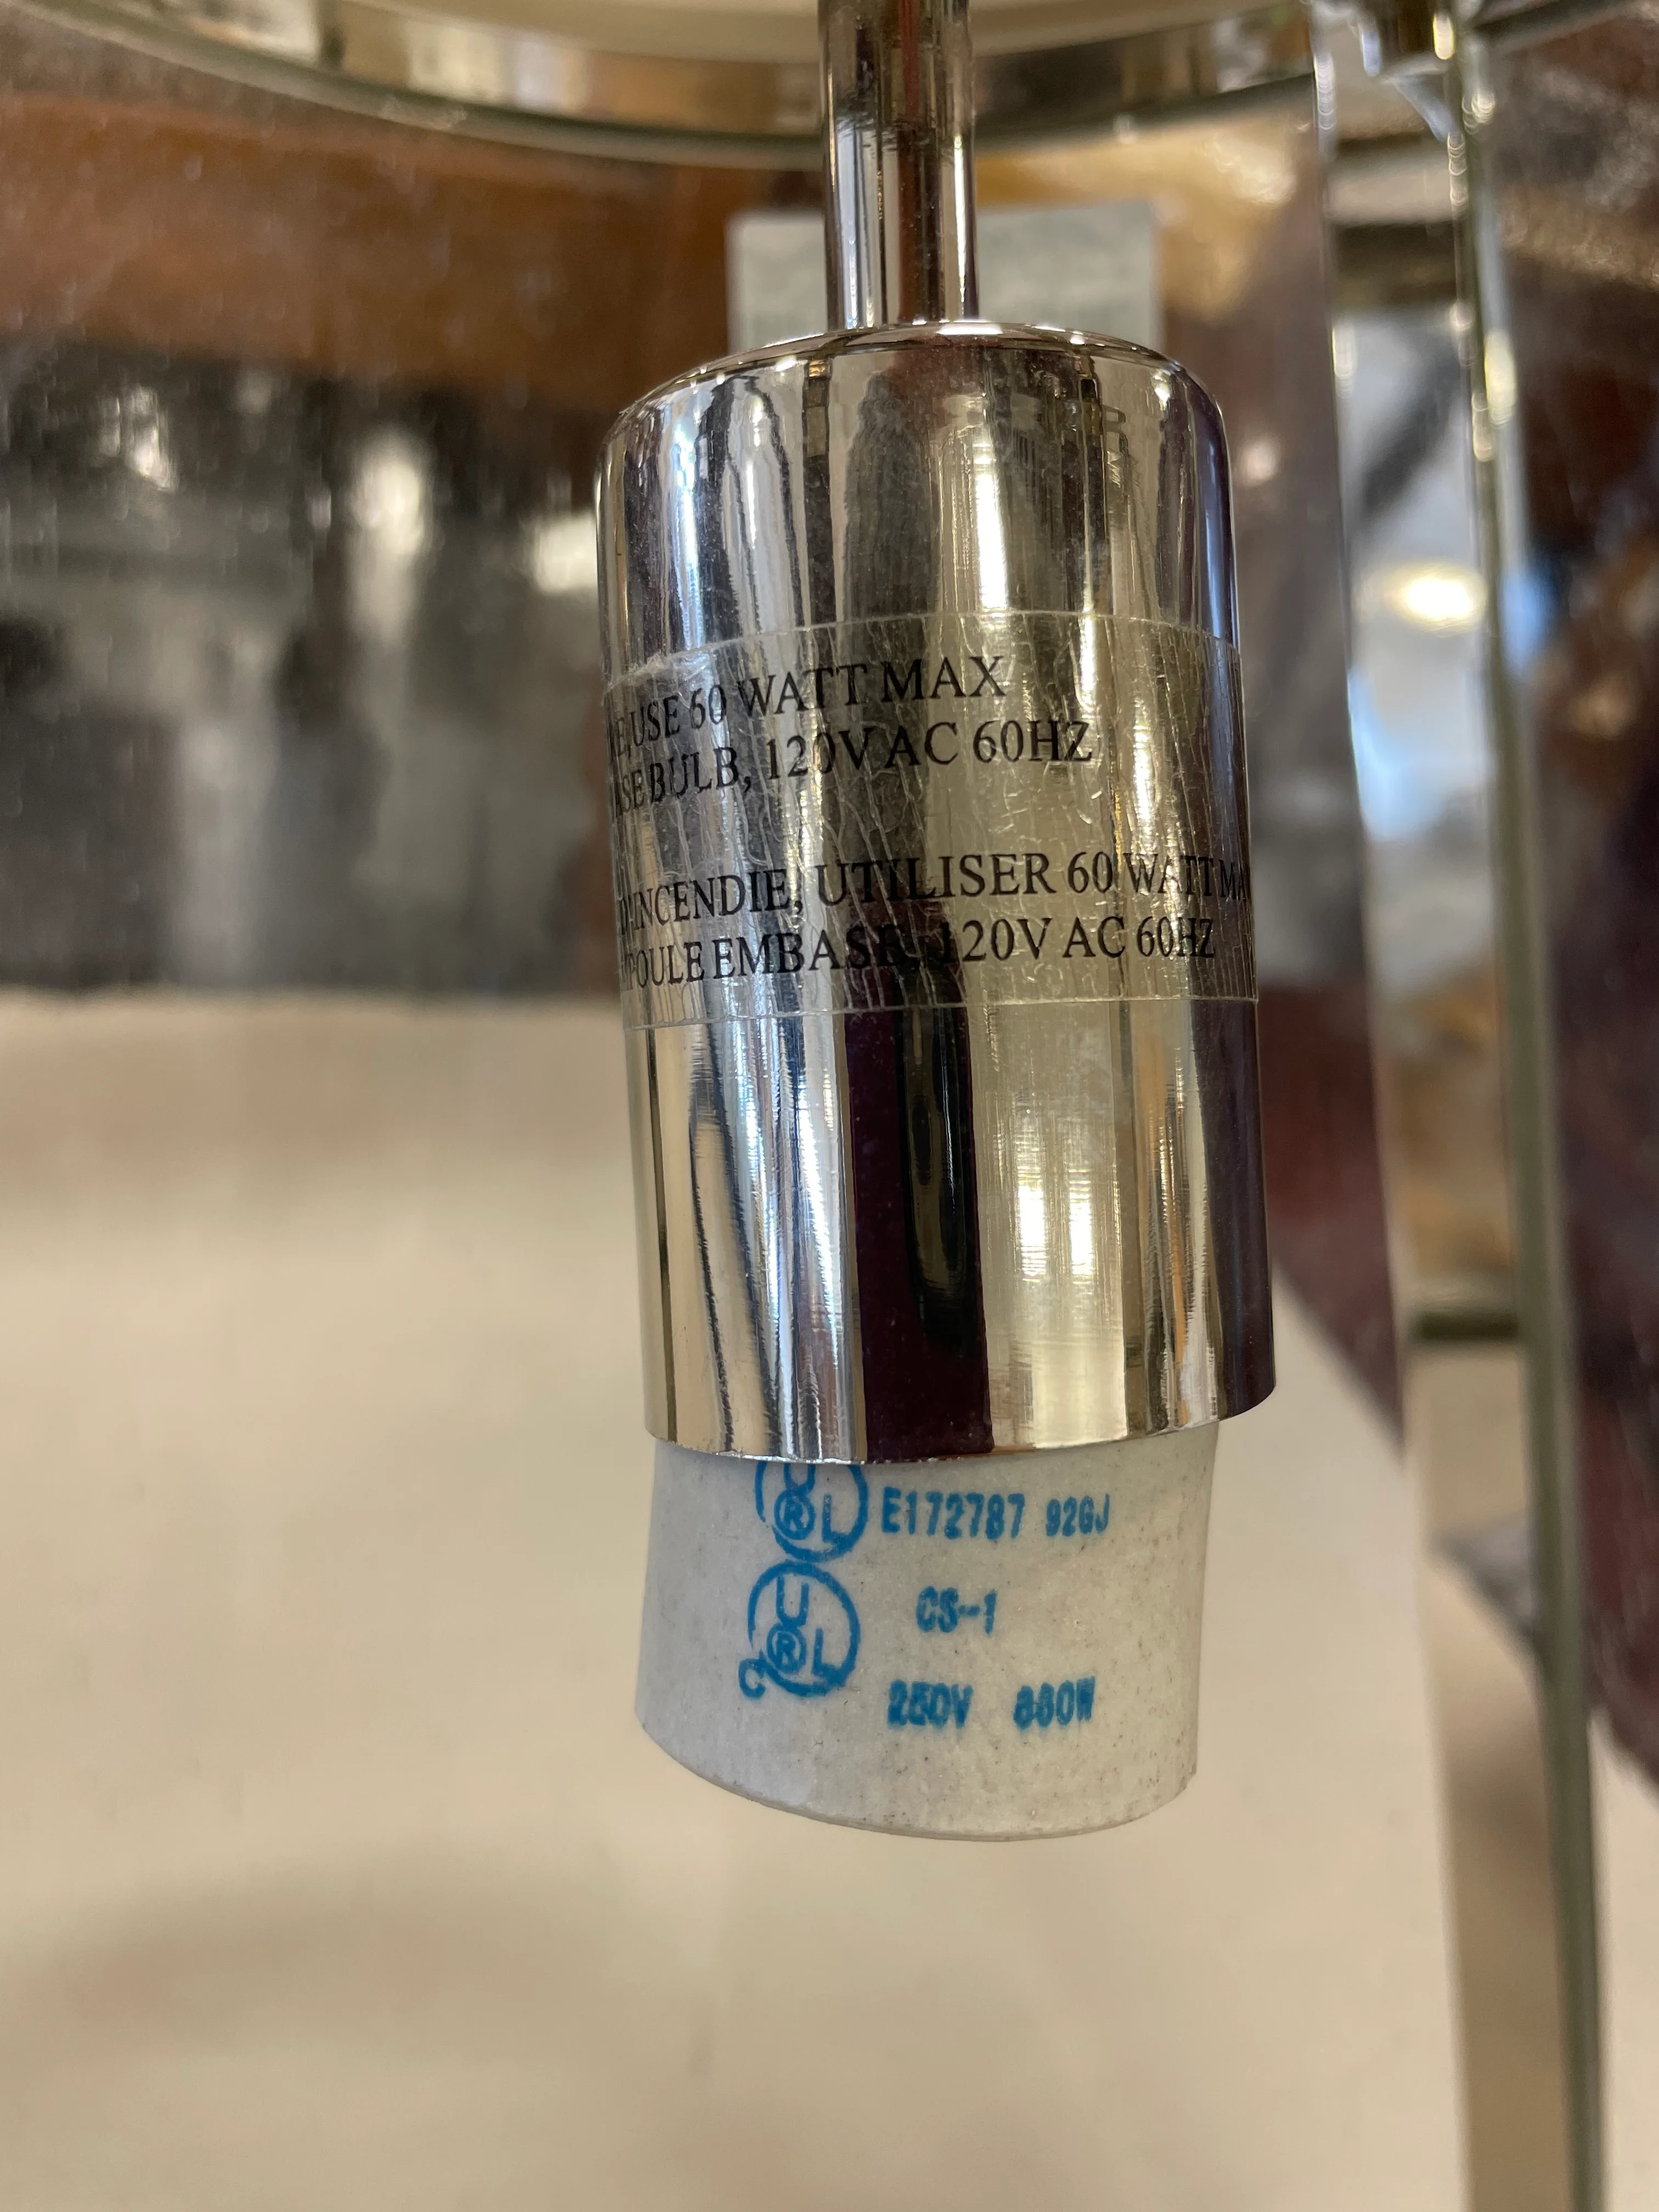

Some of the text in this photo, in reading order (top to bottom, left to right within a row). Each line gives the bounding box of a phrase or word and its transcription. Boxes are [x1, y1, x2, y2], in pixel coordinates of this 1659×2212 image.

[631, 695, 680, 747] USE
[690, 684, 727, 731] 60
[737, 662, 868, 716] WATT
[881, 655, 1006, 703] MAX
[650, 747, 752, 803] BULB,
[766, 727, 875, 780] 120V
[885, 721, 958, 769] AC
[973, 719, 1092, 765] 60HZ
[817, 853, 1056, 906] UTILISER
[1066, 851, 1113, 894] 60
[1123, 853, 1214, 897] WATT
[940, 917, 1053, 964] 120V
[1062, 916, 1125, 959] AC
[1136, 916, 1215, 958] 60HZ
[882, 1486, 1026, 1540] E172787
[916, 1585, 998, 1634] CS-1
